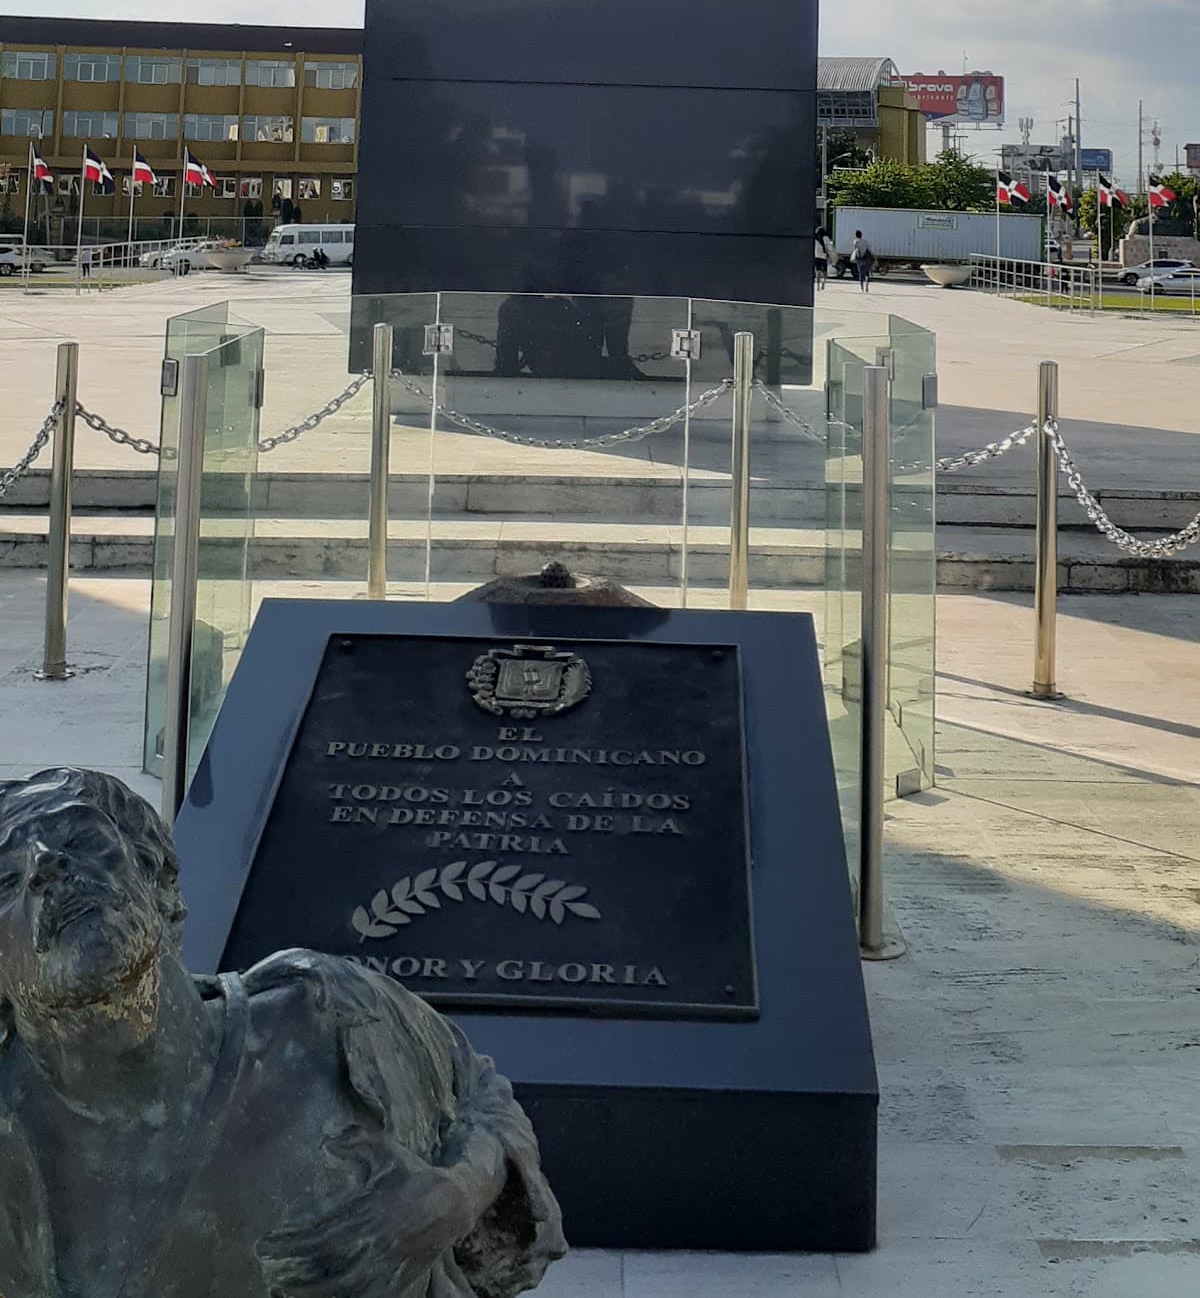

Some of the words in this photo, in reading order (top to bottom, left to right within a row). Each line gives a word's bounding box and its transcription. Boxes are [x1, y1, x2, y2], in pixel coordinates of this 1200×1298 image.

[908, 81, 953, 92] brava
[498, 726, 543, 741] EL
[326, 741, 460, 759] PUEBLO
[470, 746, 706, 765] DOMINICANO
[502, 771, 525, 786] A
[329, 784, 449, 802] TODOS
[462, 789, 533, 806] LOS
[549, 787, 691, 810] CAÍDOS
[329, 806, 379, 822] EN
[387, 808, 553, 829] DEFENSA
[567, 814, 614, 831] DE
[631, 815, 683, 834] LA
[428, 831, 569, 854] PATRIA
[344, 955, 448, 978] NOR
[460, 959, 486, 978] Y
[496, 959, 669, 986] GLORIA
